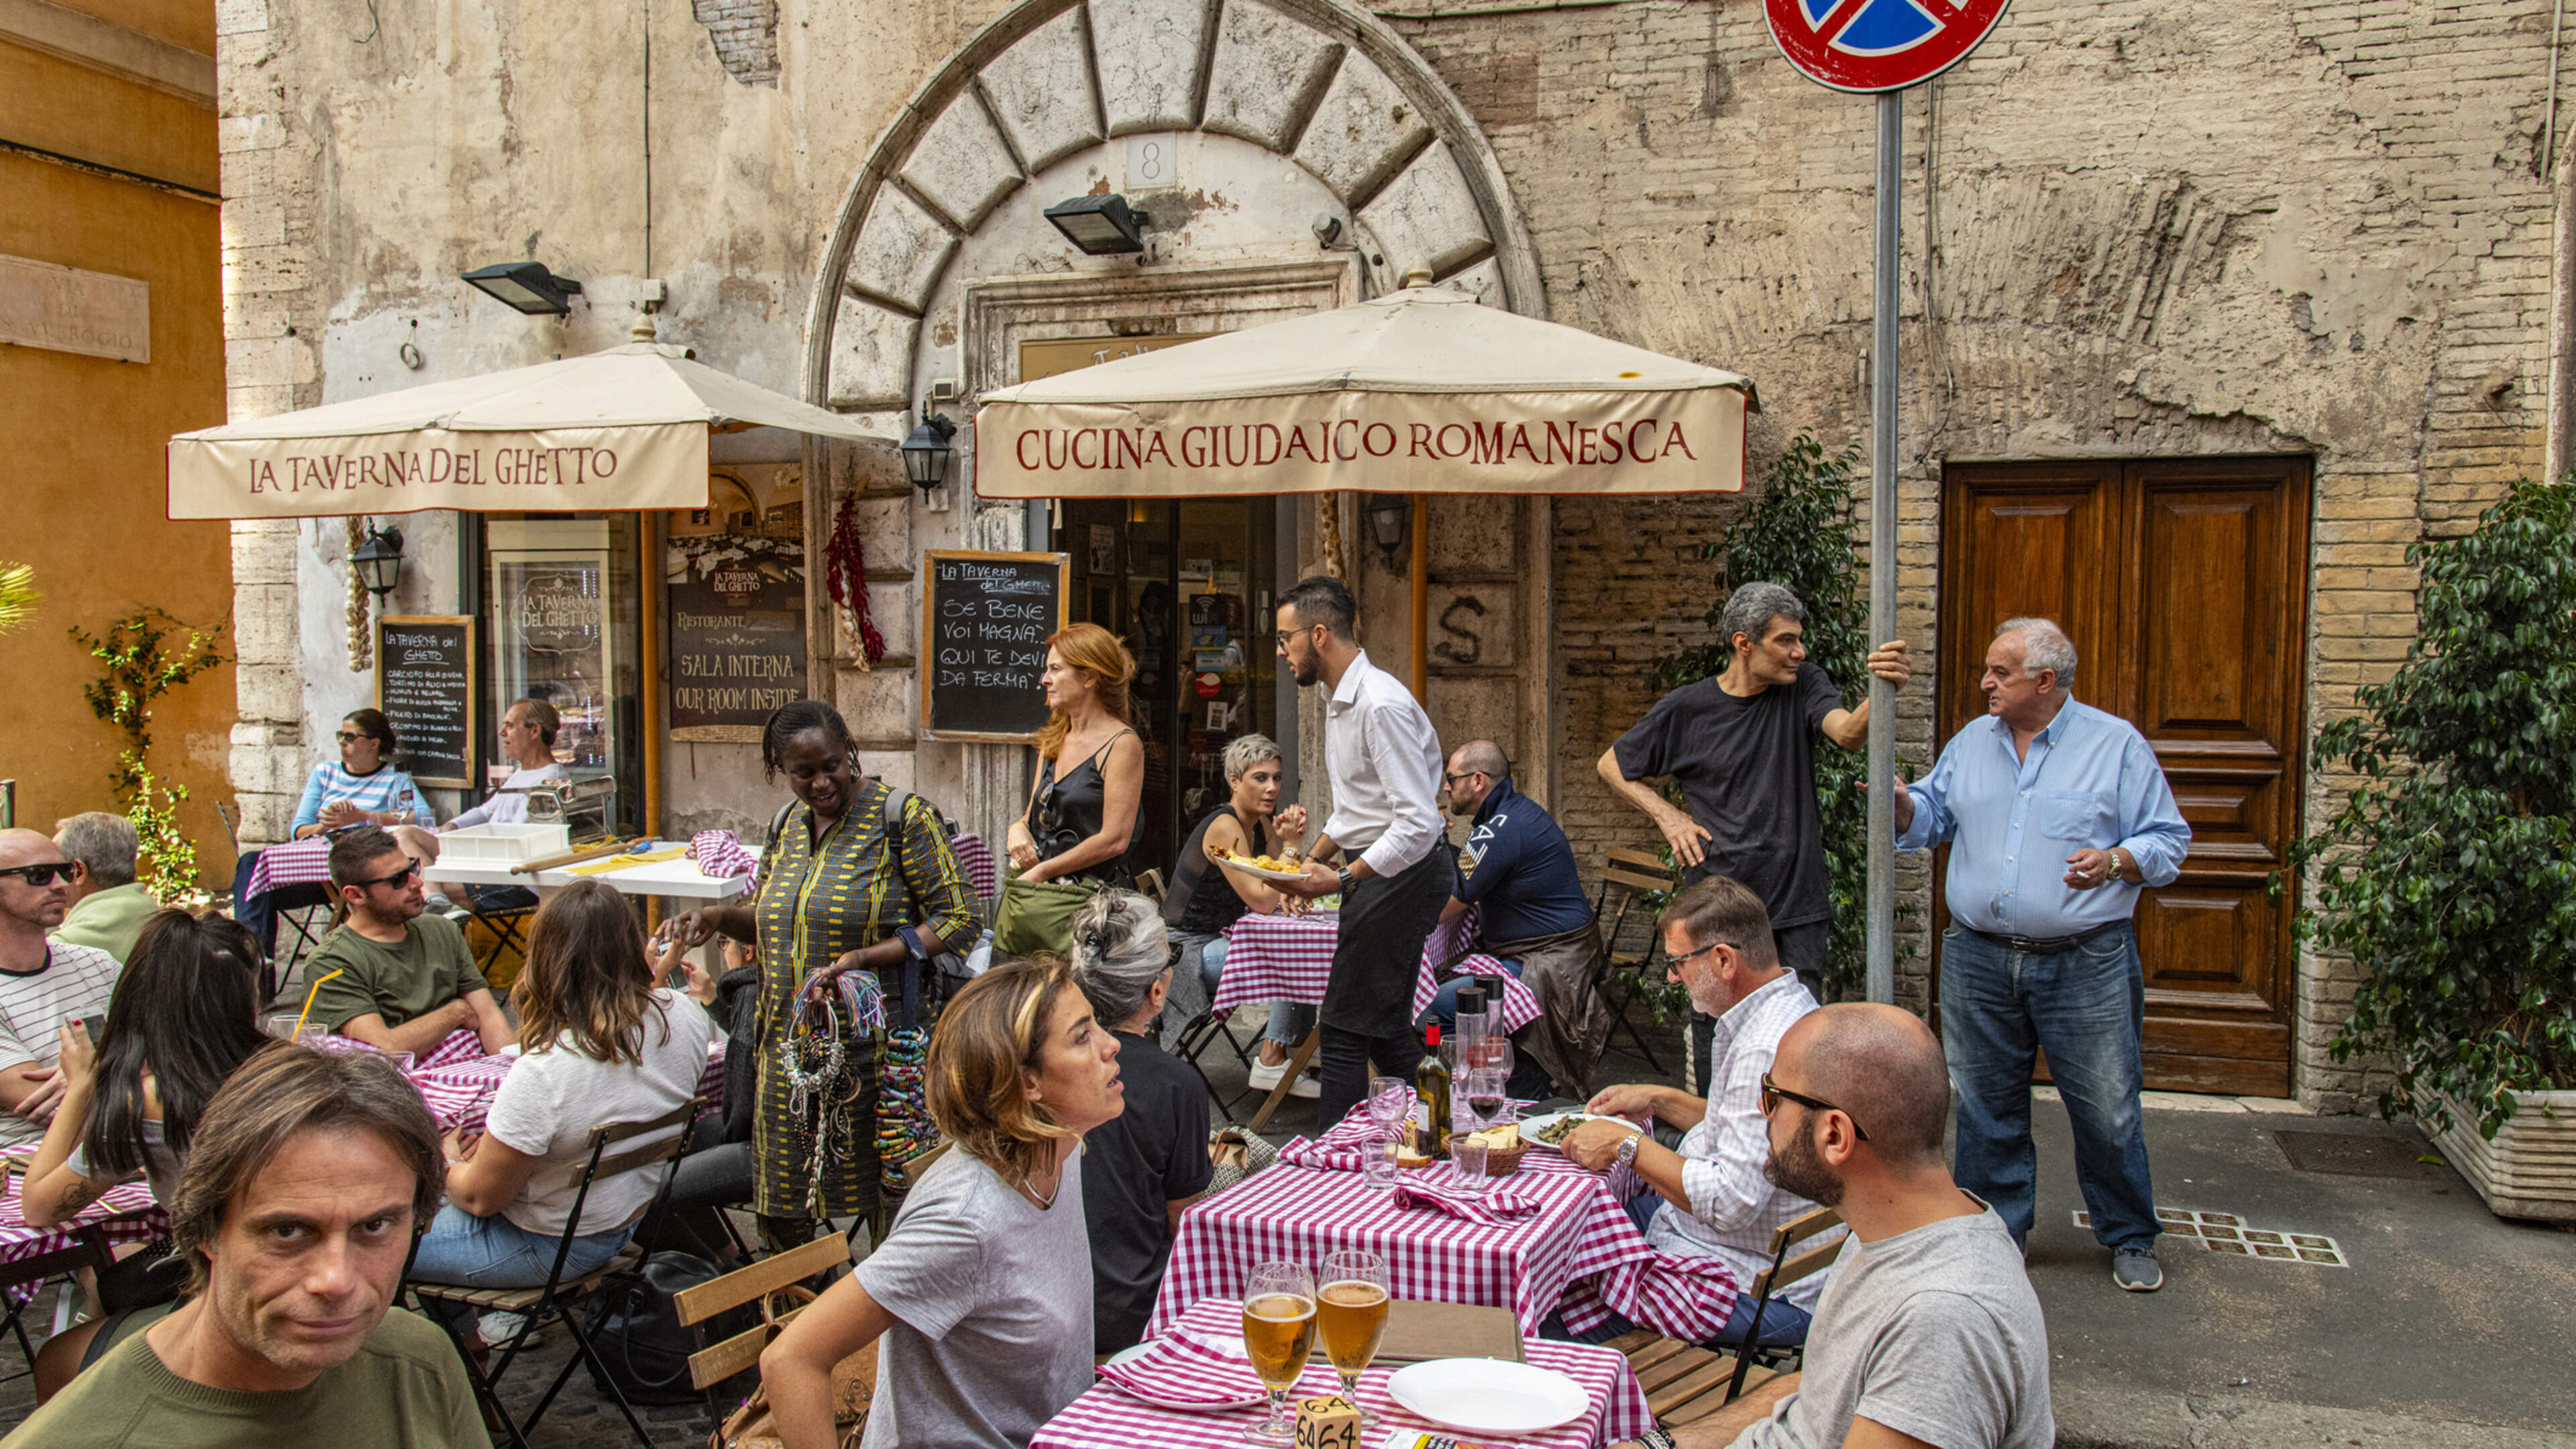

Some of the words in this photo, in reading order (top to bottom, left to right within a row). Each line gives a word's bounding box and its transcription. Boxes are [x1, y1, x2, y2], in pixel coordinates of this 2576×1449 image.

[1142, 142, 1161, 179] 8
[52, 276, 84, 296] VIA
[60, 303, 78, 317] DI
[1016, 427, 1177, 470] CUCINA
[1181, 419, 1397, 468] GIUDAICO
[1407, 419, 1697, 465] ROMANESCA
[249, 459, 281, 493] LA
[286, 451, 425, 492] TAVERNA
[427, 448, 487, 484] DEL
[495, 447, 618, 485] GHETTO
[714, 572, 722, 582] LA
[724, 572, 759, 582] TAVERNA
[942, 563, 957, 577] LA
[959, 563, 1017, 578] TAVERNA
[714, 582, 727, 592] DEL
[729, 581, 760, 592] GHETTO
[523, 595, 537, 610] LA
[538, 594, 596, 610] TAVERNA
[943, 599, 977, 617] SE
[985, 599, 1044, 620] BENE
[523, 611, 544, 627] DEL
[546, 610, 598, 627] GHETTO
[677, 611, 745, 631] RISTORANTE
[386, 630, 396, 644] LA
[396, 633, 437, 647] TAVERNA
[1434, 596, 1485, 663] S
[404, 649, 443, 661] GHETTO
[941, 648, 975, 664] QUI
[984, 649, 1002, 664] TE
[1009, 649, 1045, 668] DEVI
[682, 655, 724, 676] SALA
[729, 655, 794, 682] INTERNA
[940, 670, 966, 686] DA
[676, 687, 705, 714] OUR
[707, 688, 747, 714] ROOM
[751, 688, 800, 710] INSIDE
[1304, 1397, 1351, 1413] 64
[1297, 1415, 1315, 1449] 64
[1319, 1420, 1356, 1449] 64
